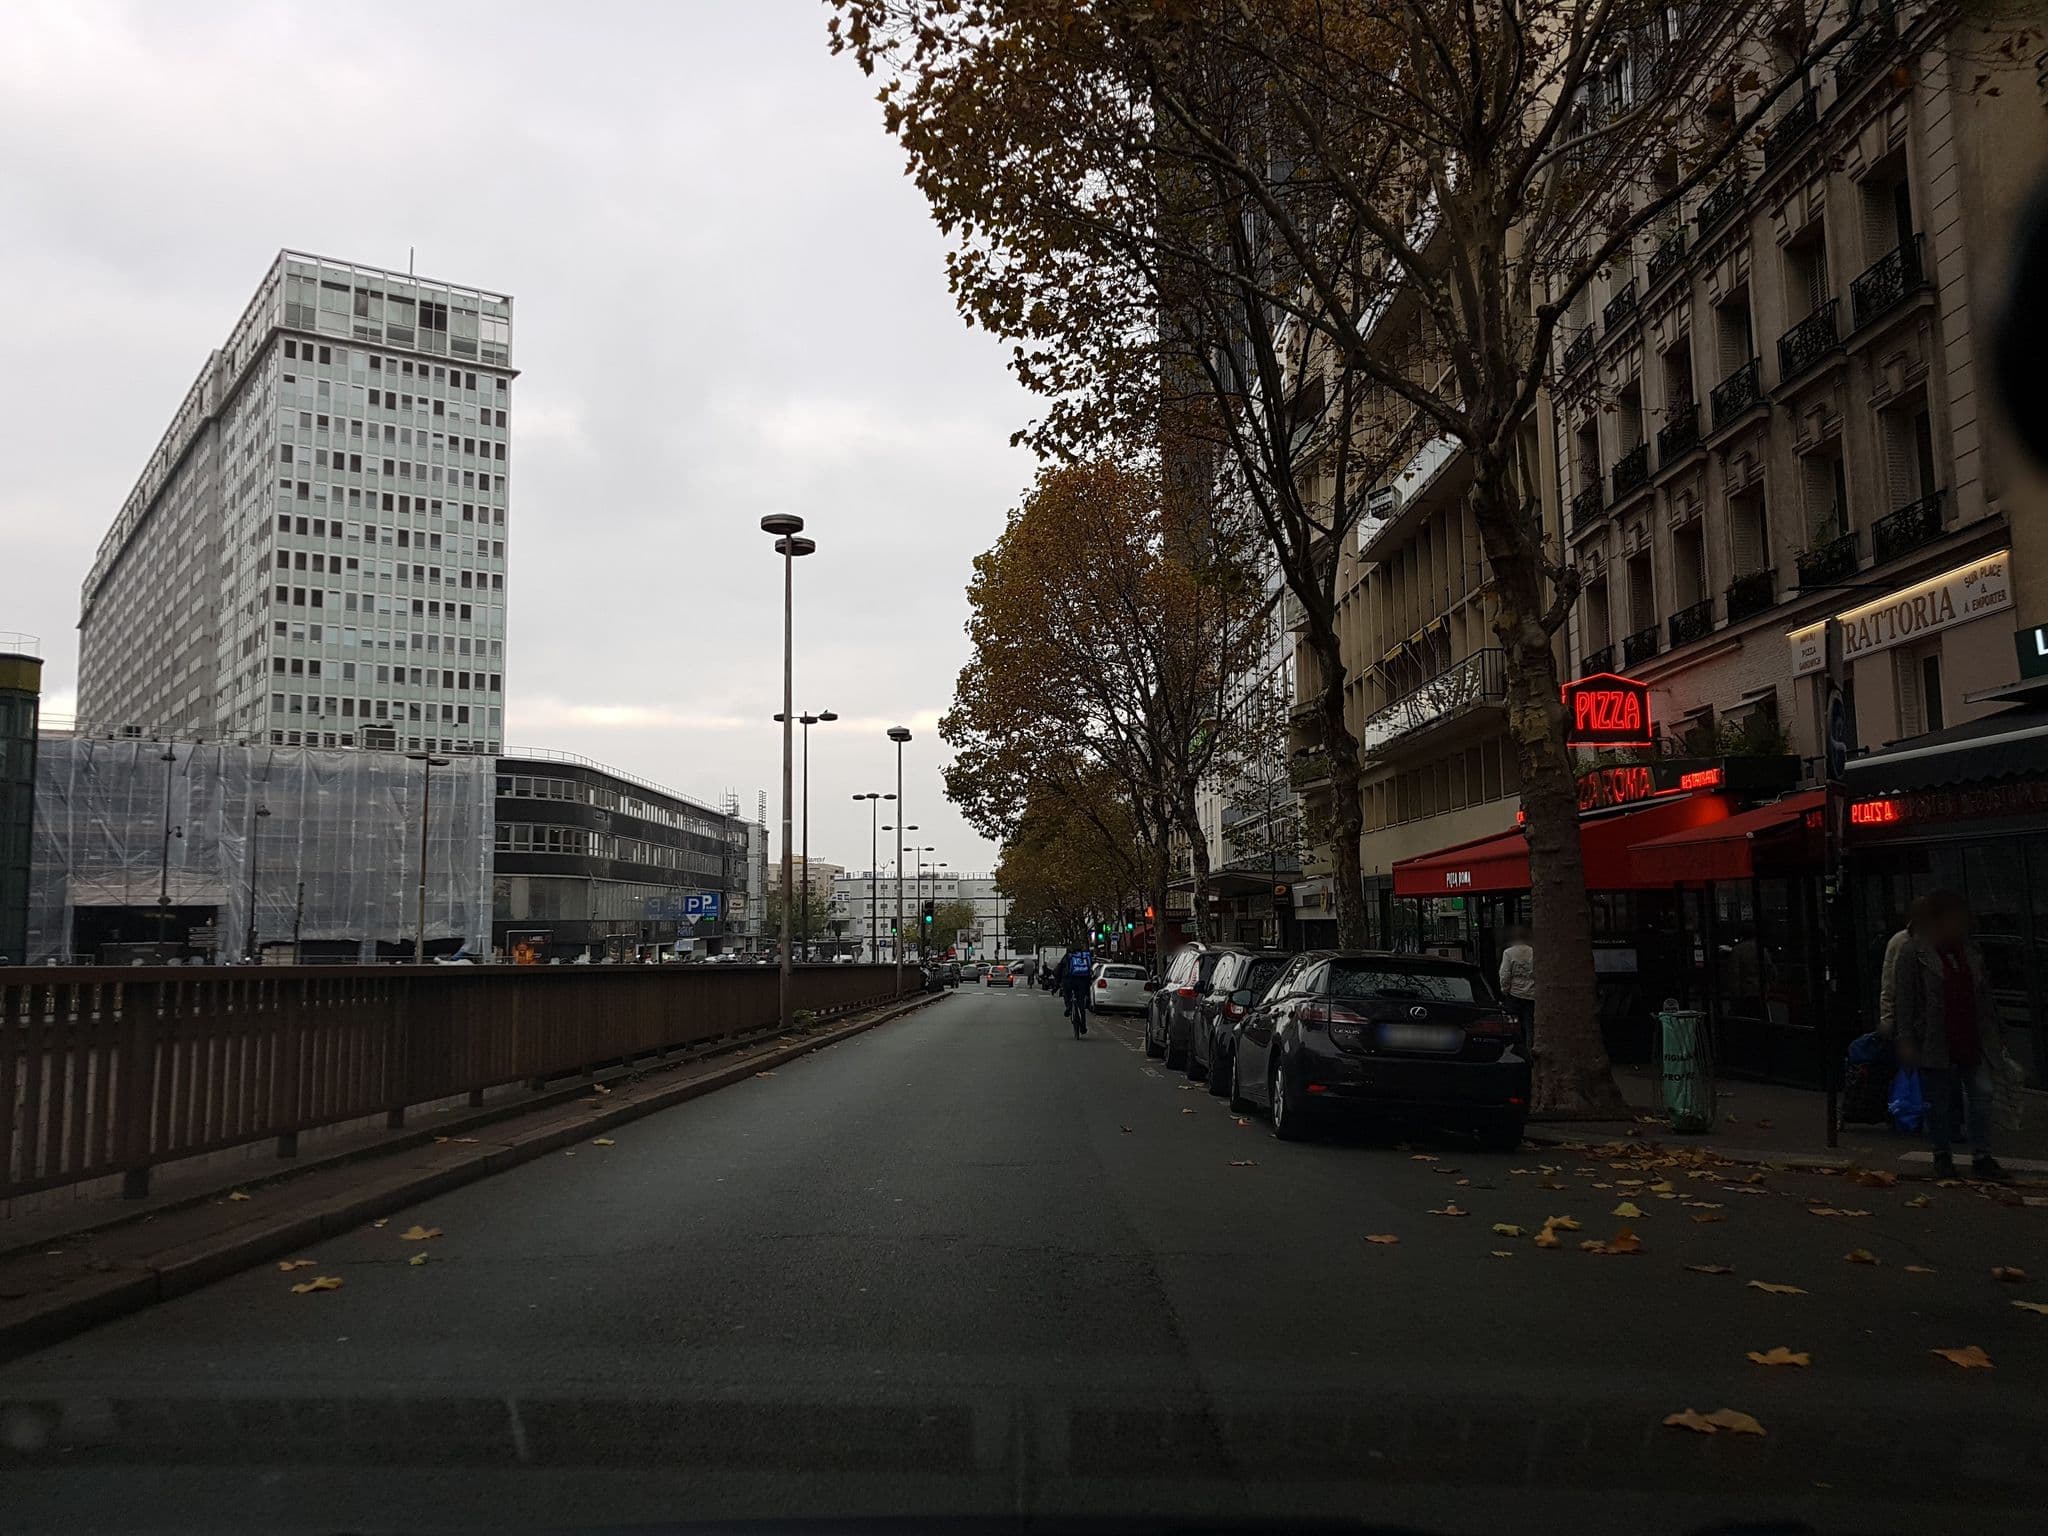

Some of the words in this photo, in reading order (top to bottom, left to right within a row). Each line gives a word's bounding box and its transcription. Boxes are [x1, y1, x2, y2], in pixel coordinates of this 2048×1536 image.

[1841, 587, 1954, 654] RATTORIA
[1575, 691, 1641, 730] PIZZA
[1852, 802, 1882, 822] PLATS
[687, 898, 700, 912] P
[702, 895, 712, 909] P
